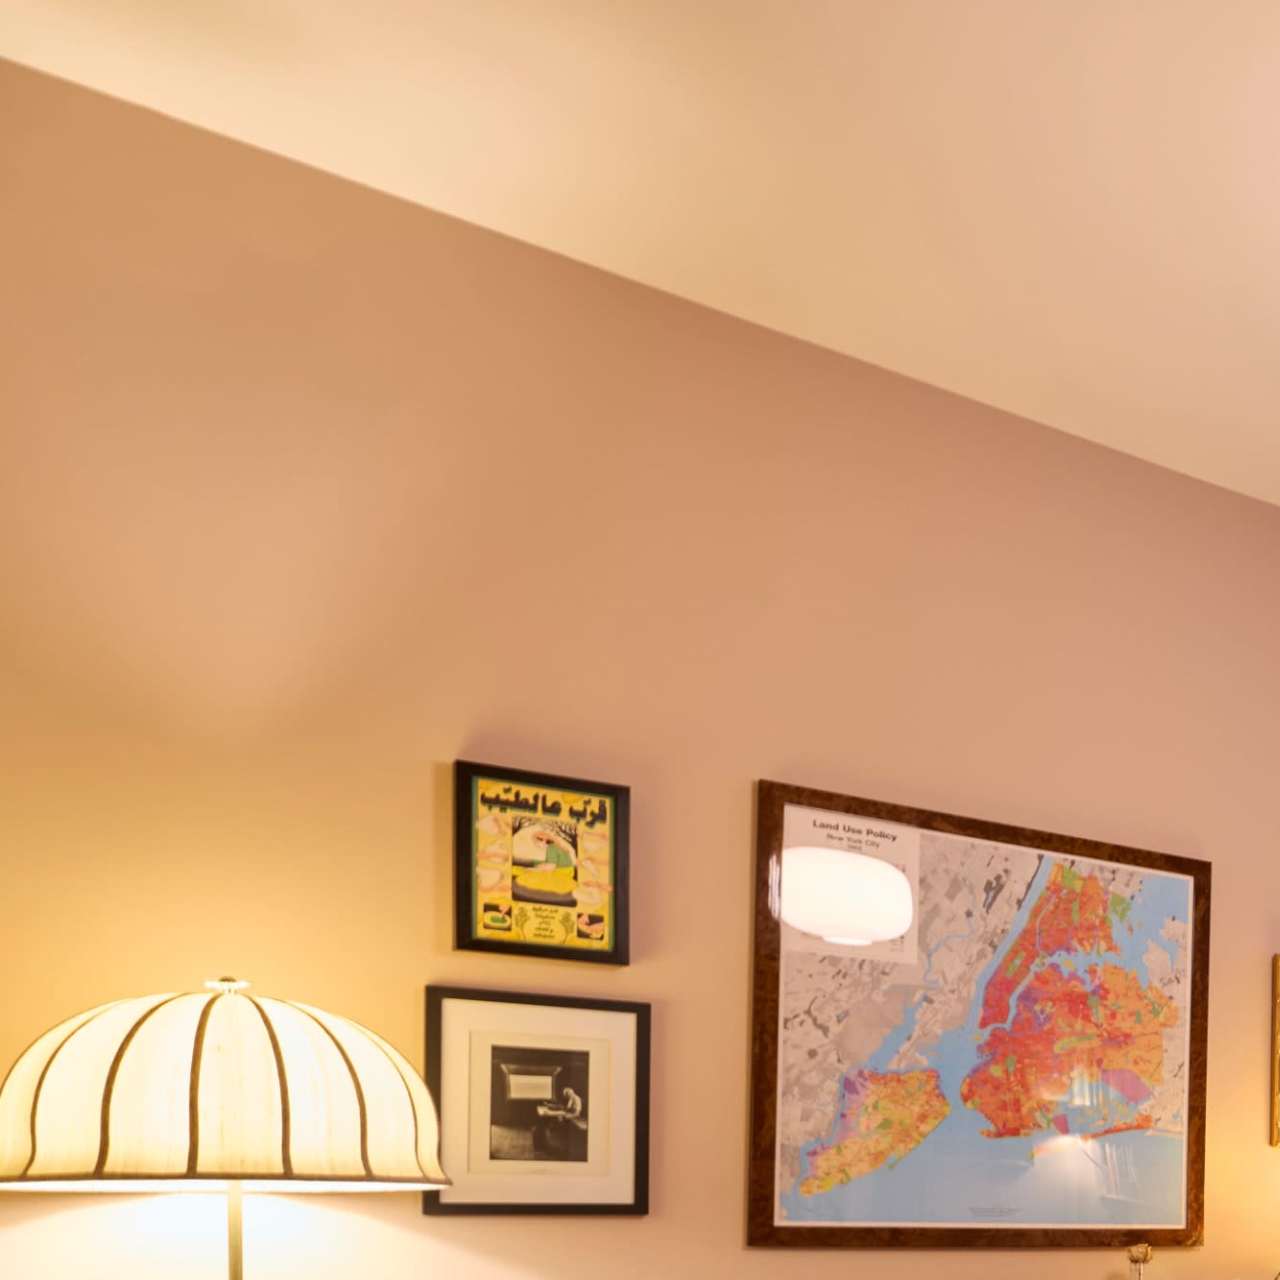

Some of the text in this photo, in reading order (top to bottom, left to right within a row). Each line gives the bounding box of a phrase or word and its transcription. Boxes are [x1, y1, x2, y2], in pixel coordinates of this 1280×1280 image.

[812, 819, 897, 841] Land Use Policy
[826, 833, 844, 841] New
[865, 840, 881, 848] City
